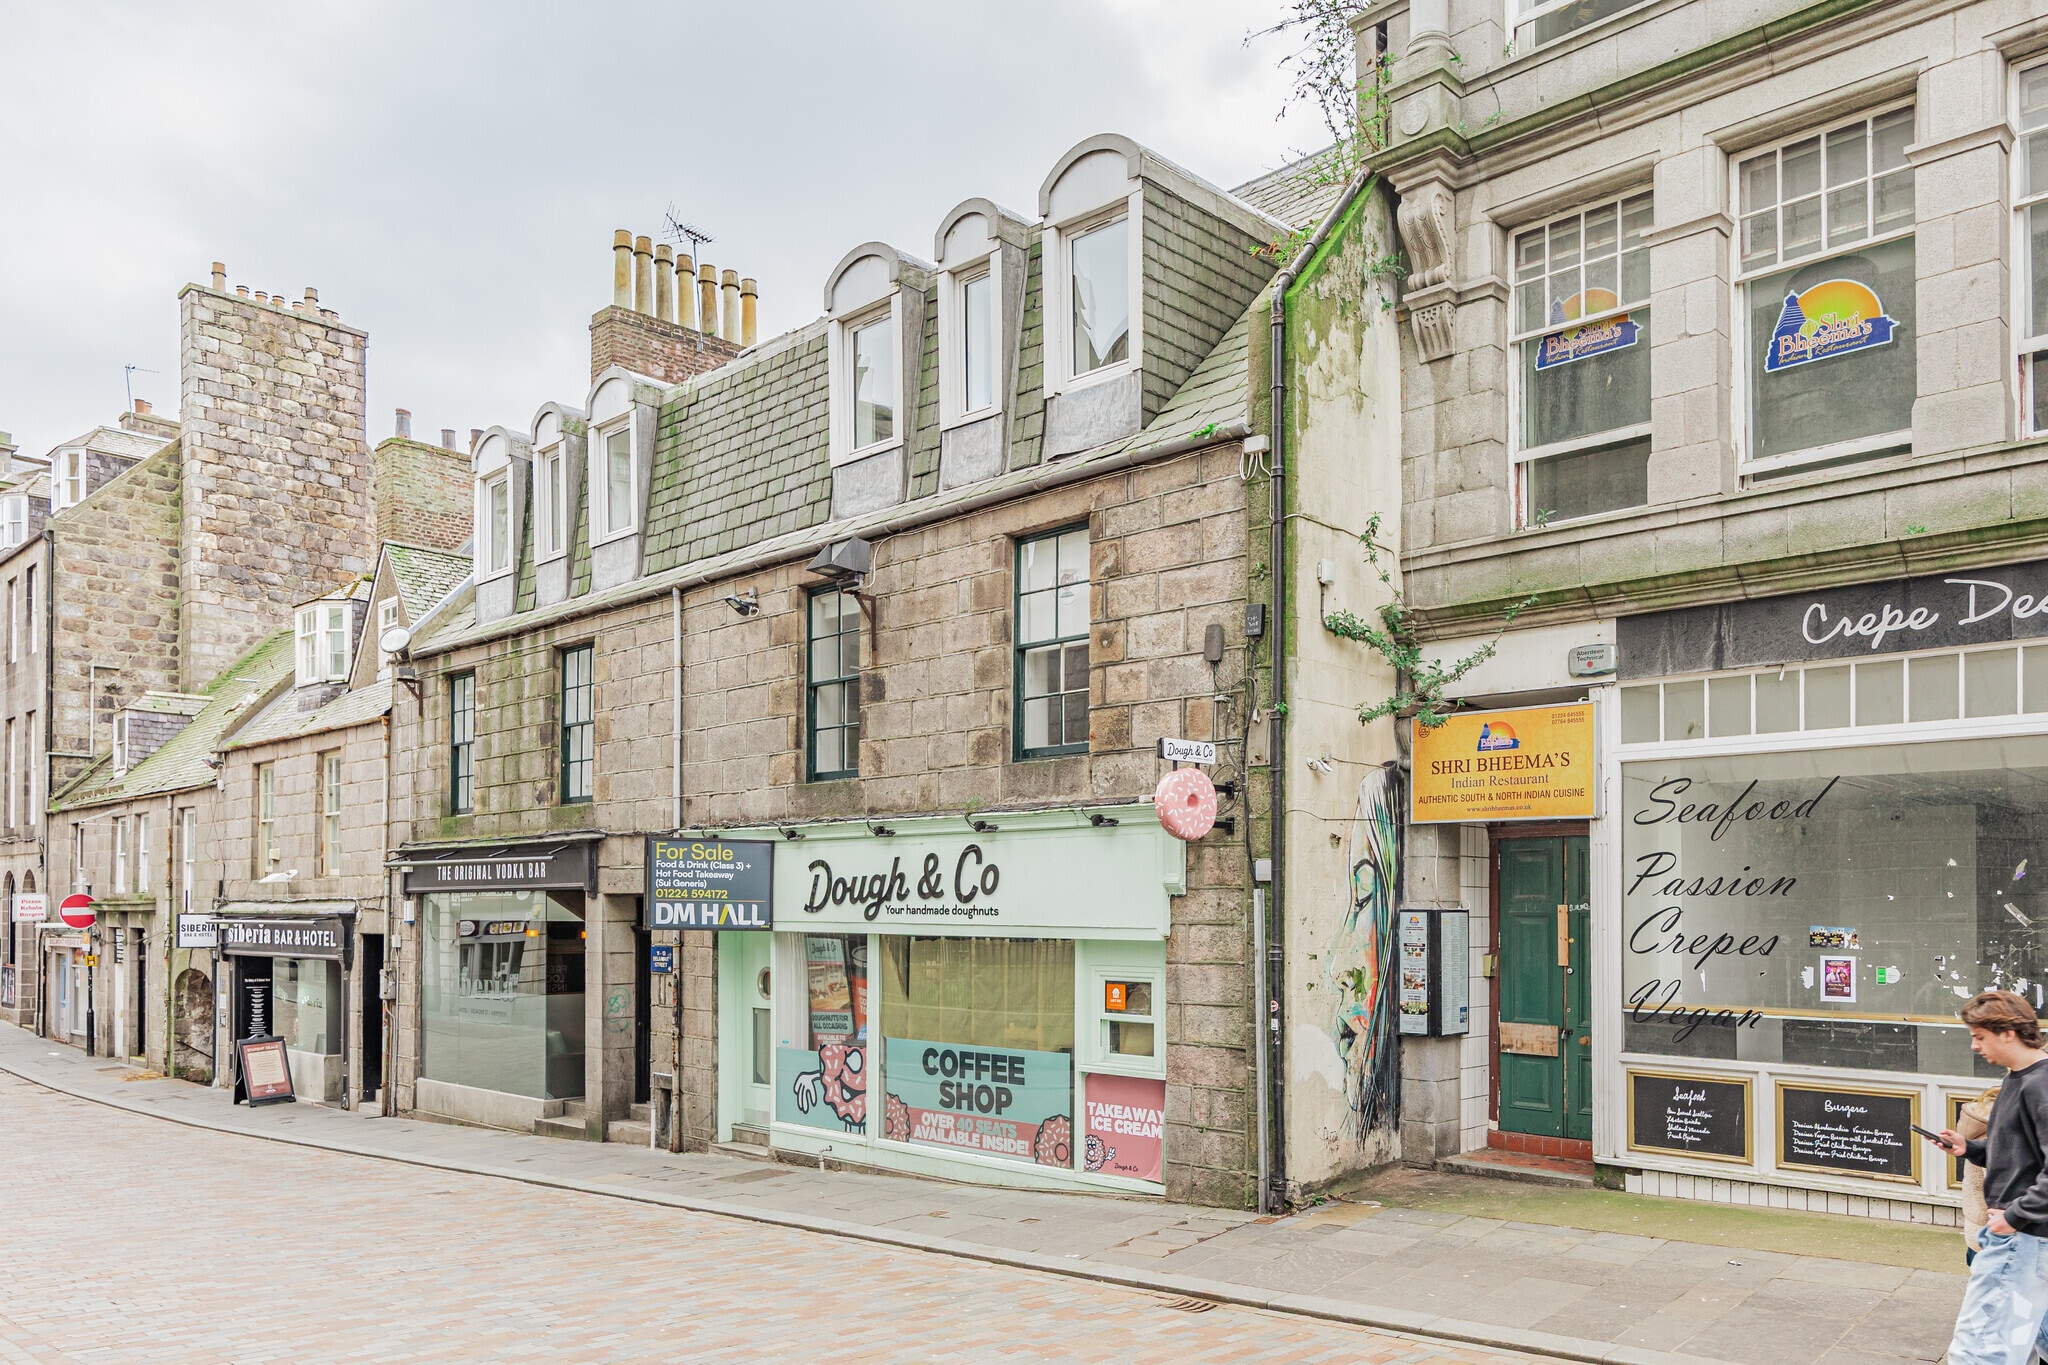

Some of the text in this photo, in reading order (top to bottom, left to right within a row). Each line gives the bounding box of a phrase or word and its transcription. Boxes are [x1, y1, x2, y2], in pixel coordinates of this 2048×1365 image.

[1819, 311, 1860, 334] Shri
[1546, 324, 1622, 356] Bheema's
[1778, 321, 1872, 356] Bheema's
[1546, 338, 1620, 364] Indian Restaurant
[1778, 336, 1870, 364] Indian Restaurant
[1802, 602, 1939, 650] Crepe
[1167, 742, 1213, 759] Dough & Co
[1432, 752, 1570, 775] SHRI BHEEMA'S
[1451, 774, 1549, 789] Indian Restaurant
[1419, 788, 1584, 804] AUTHENTIC SOUTH & NORTH INDIAN CUISINE
[1466, 804, 1532, 813] www.shribheemas.co.uk
[1633, 775, 1840, 841] Seafood
[656, 842, 734, 860] For Sale
[437, 862, 546, 881] THE ORIGINAL VODKA BAR
[656, 860, 676, 868] Food
[710, 862, 734, 870] (Class
[736, 862, 744, 871] 3)
[695, 871, 734, 880] Takeaway
[1627, 851, 1797, 897] Passion
[656, 879, 707, 889] (Sui Generis)
[804, 844, 999, 921] Dough & Co
[656, 889, 728, 899] 01224 594172
[656, 902, 766, 925] DM HALL
[885, 905, 999, 919] Your handmade doughnuts
[181, 924, 216, 932] SIBERIA
[228, 924, 337, 947] siberia BAR & HOTEL
[1630, 906, 1780, 970] Crepes
[812, 944, 826, 956] Dough
[831, 942, 836, 952] Co
[1630, 979, 1764, 1044] Vegan
[922, 1048, 1025, 1085] COFFEE
[939, 1080, 1013, 1115] SHOP
[1673, 1086, 1706, 1106] Seafood
[1087, 1102, 1165, 1125] TAKEAWAY
[1824, 1099, 1868, 1118] Burgers
[922, 1112, 1018, 1139] OVER 40 SEATS
[1091, 1116, 1163, 1139] ICE CREAM
[1874, 1129, 1894, 1139] Burger
[914, 1124, 1029, 1155] AVAILABLE INSIDE!
[1830, 1134, 1849, 1143] Burger
[1852, 1145, 1872, 1154] Burger
[1869, 1155, 1888, 1165] Burger
[1114, 1162, 1128, 1171] Dough
